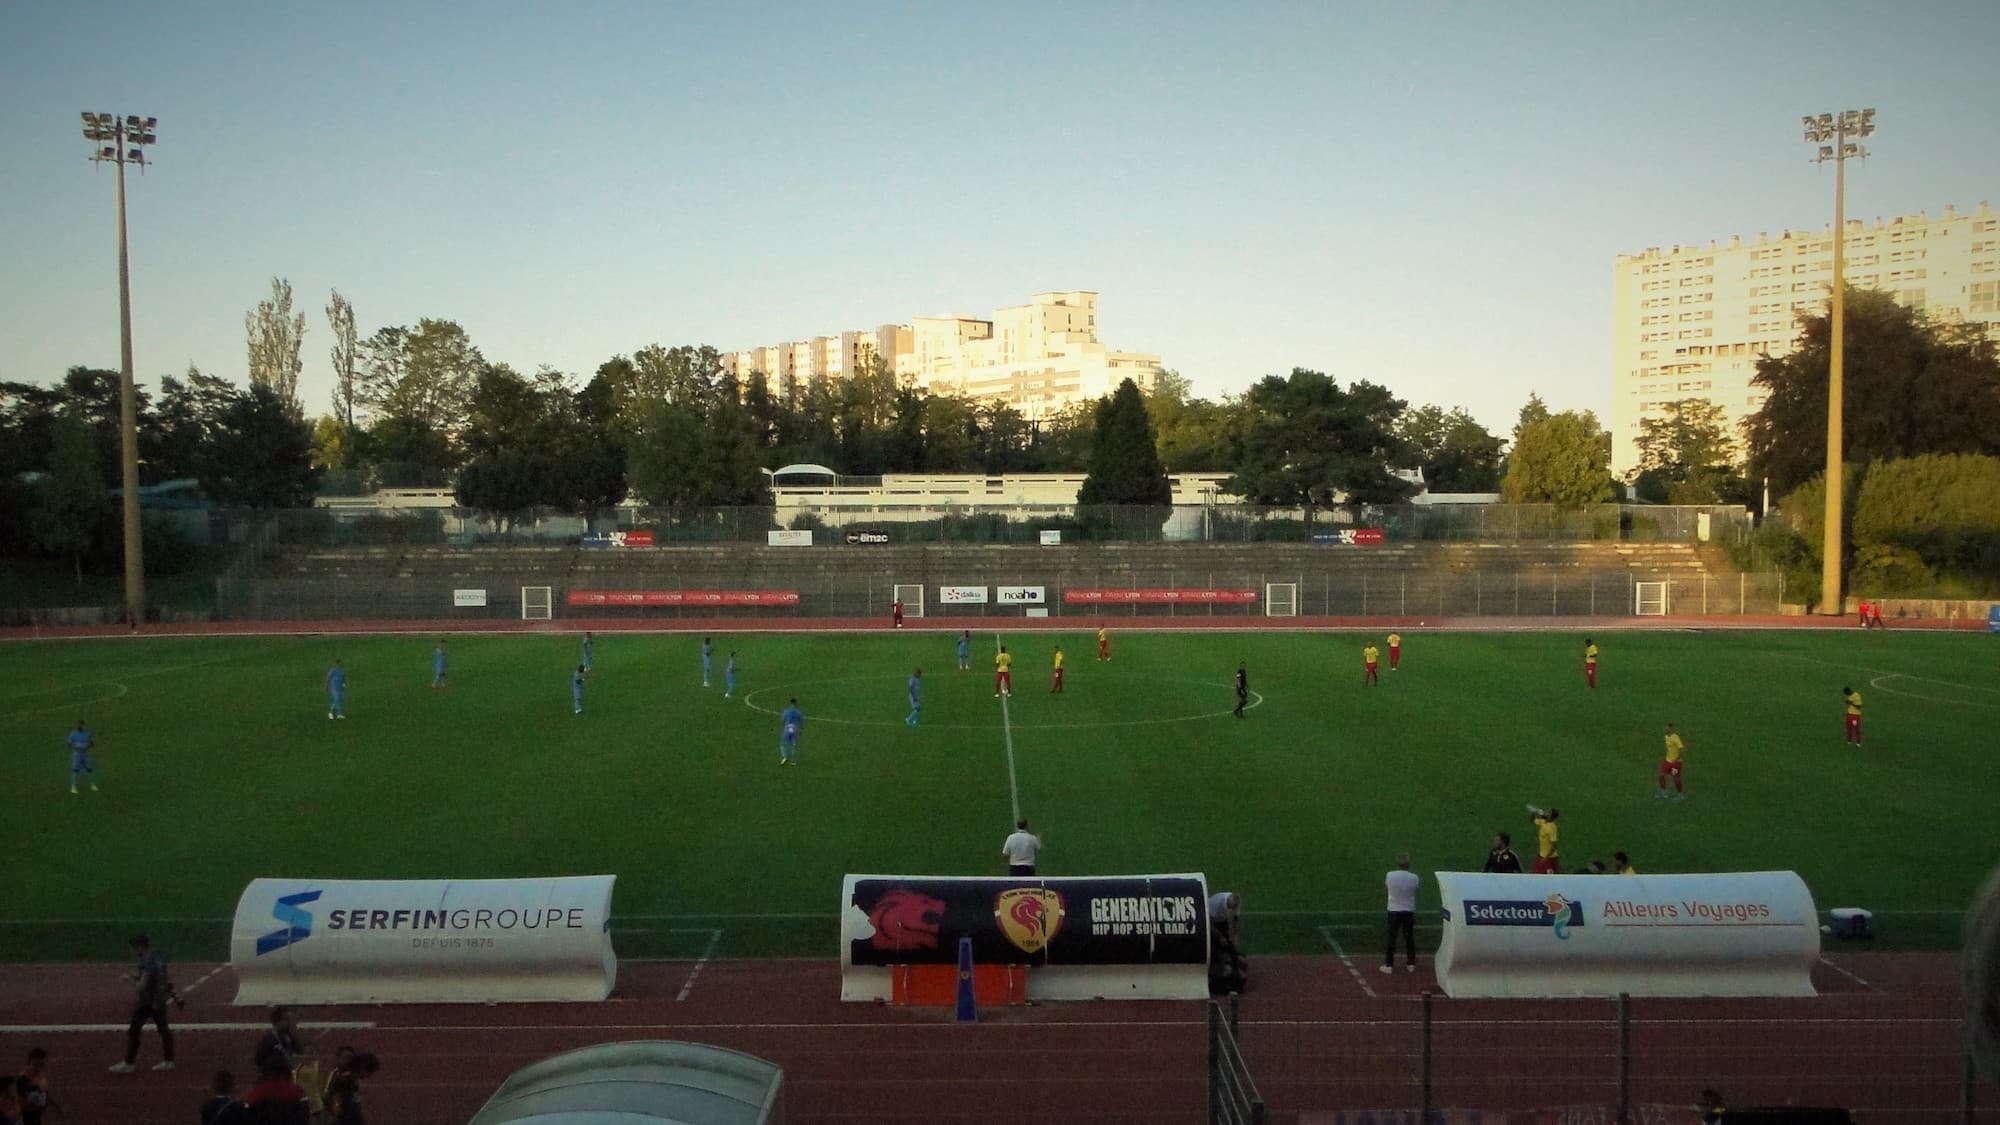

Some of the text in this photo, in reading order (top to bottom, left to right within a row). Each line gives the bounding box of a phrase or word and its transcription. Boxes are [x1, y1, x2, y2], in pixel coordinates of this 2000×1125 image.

[327, 907, 585, 930] SERFIMGROUPE
[1091, 896, 1196, 922] GENERATIONS
[1470, 904, 1545, 921] Selectour
[1604, 901, 1770, 922] Ailleurs Voyages
[1092, 923, 1110, 935] HIP
[1113, 923, 1134, 935] HOP
[1136, 923, 1162, 935] SOUL
[467, 938, 495, 948] 1875
